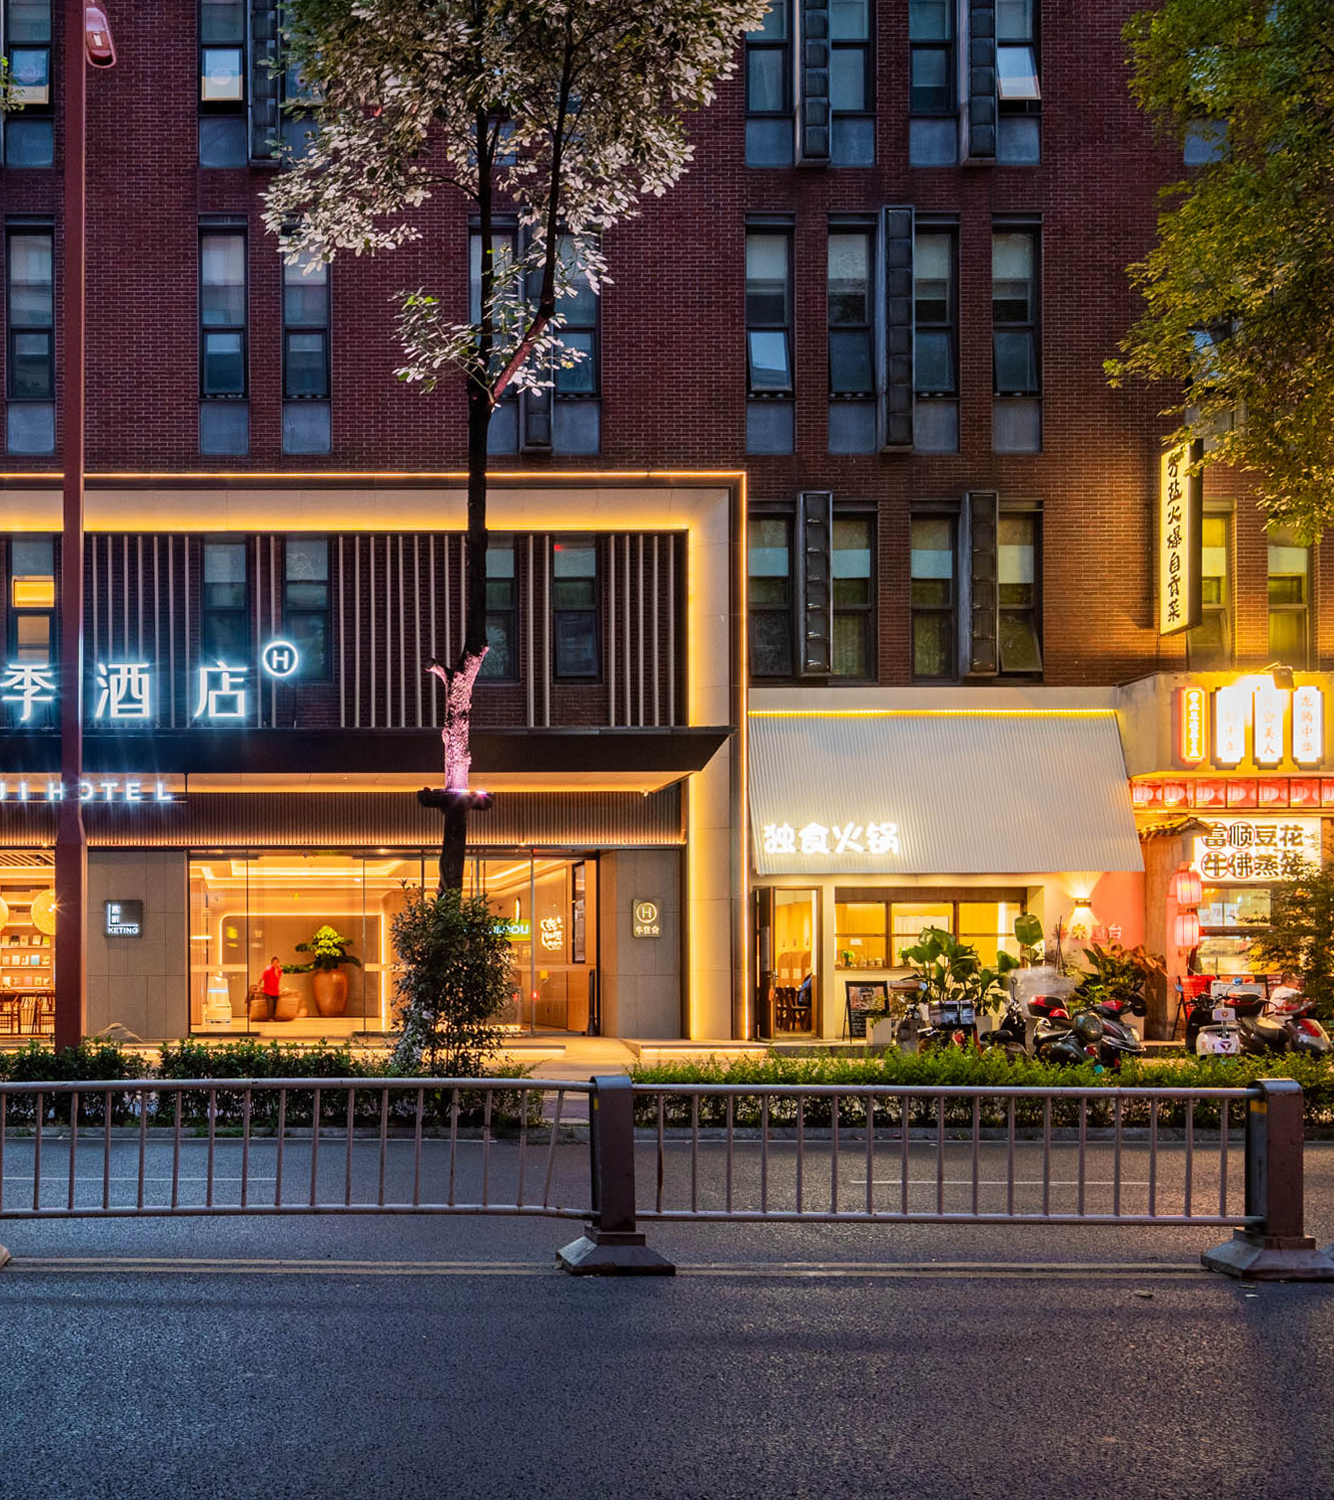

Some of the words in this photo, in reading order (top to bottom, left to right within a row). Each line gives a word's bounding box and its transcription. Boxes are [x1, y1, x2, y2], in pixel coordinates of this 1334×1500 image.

[48, 781, 173, 801] HOTEL
[763, 821, 899, 854] 独食火锅
[1204, 824, 1305, 847] 富顺豆花
